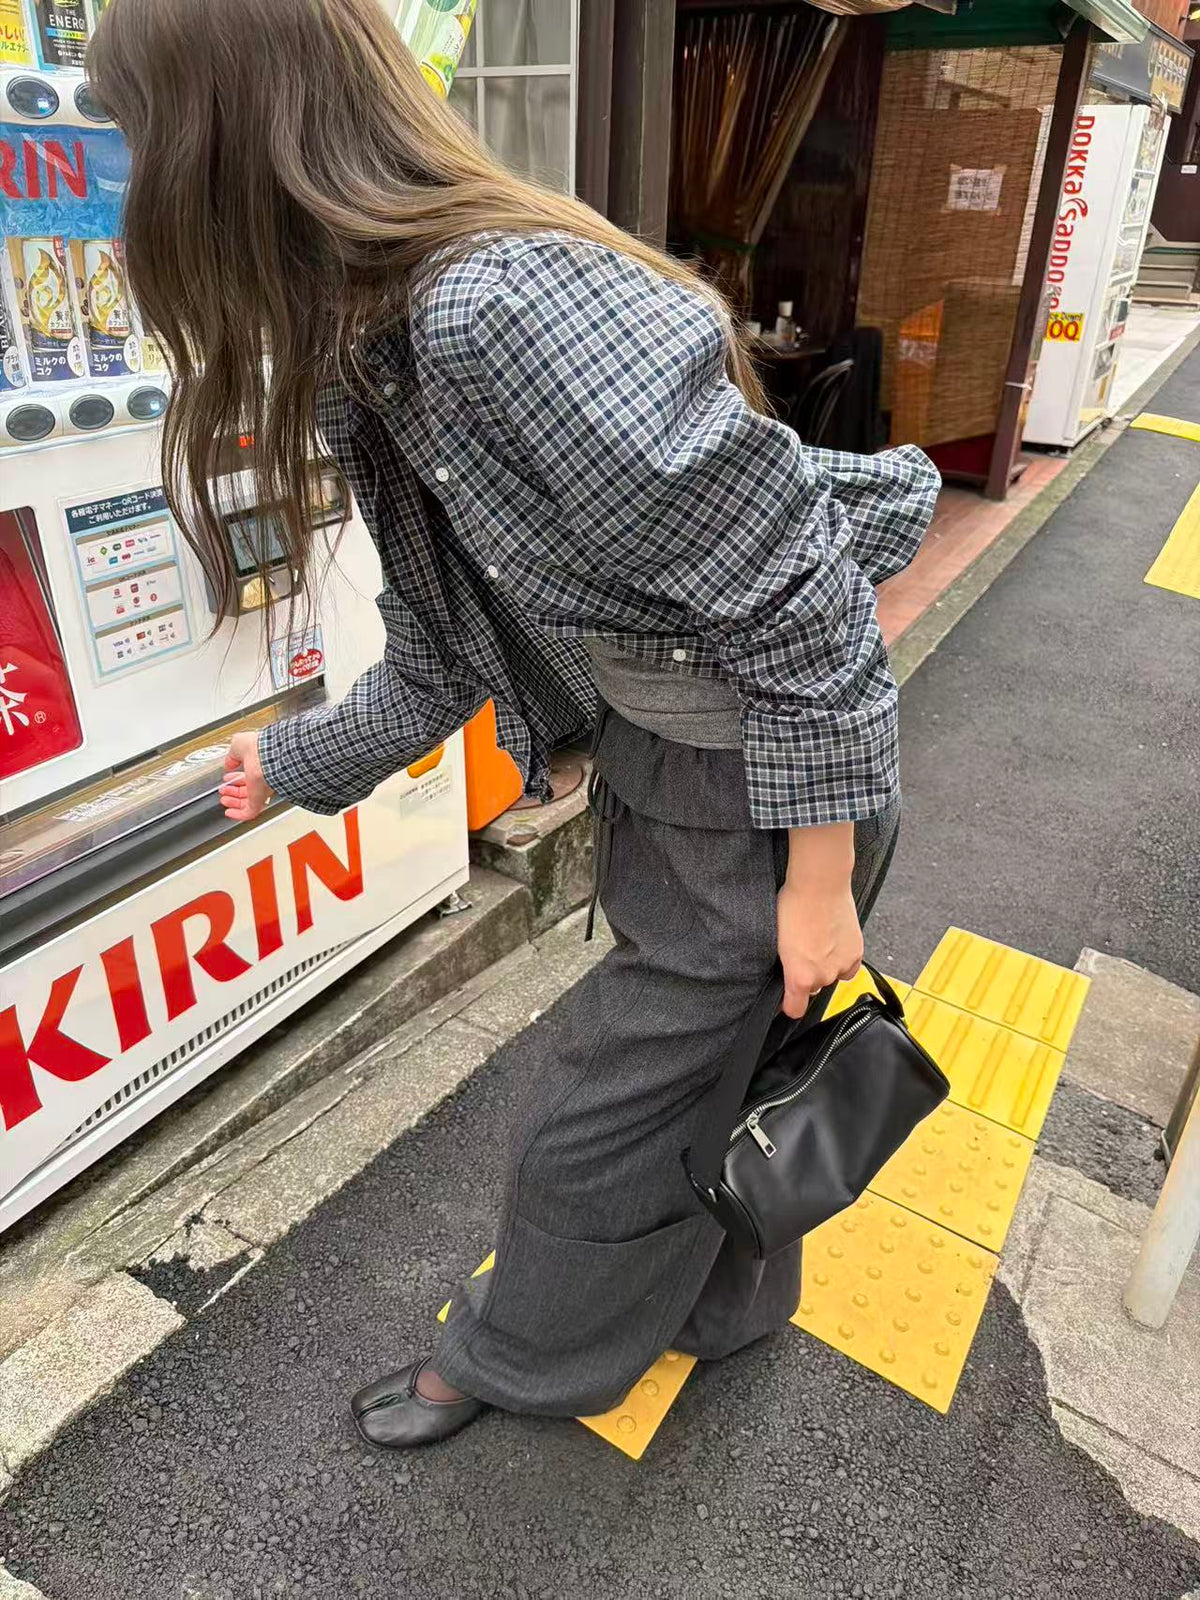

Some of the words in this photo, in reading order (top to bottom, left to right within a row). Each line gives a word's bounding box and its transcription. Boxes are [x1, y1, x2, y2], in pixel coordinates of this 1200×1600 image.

[49, 14, 86, 30] ENERG
[0, 139, 87, 200] RIN
[35, 356, 66, 366] ミルクの
[93, 353, 122, 363] ミルクの
[36, 366, 52, 376] コク
[94, 363, 109, 372] コク
[0, 806, 365, 1132] KIRIN
